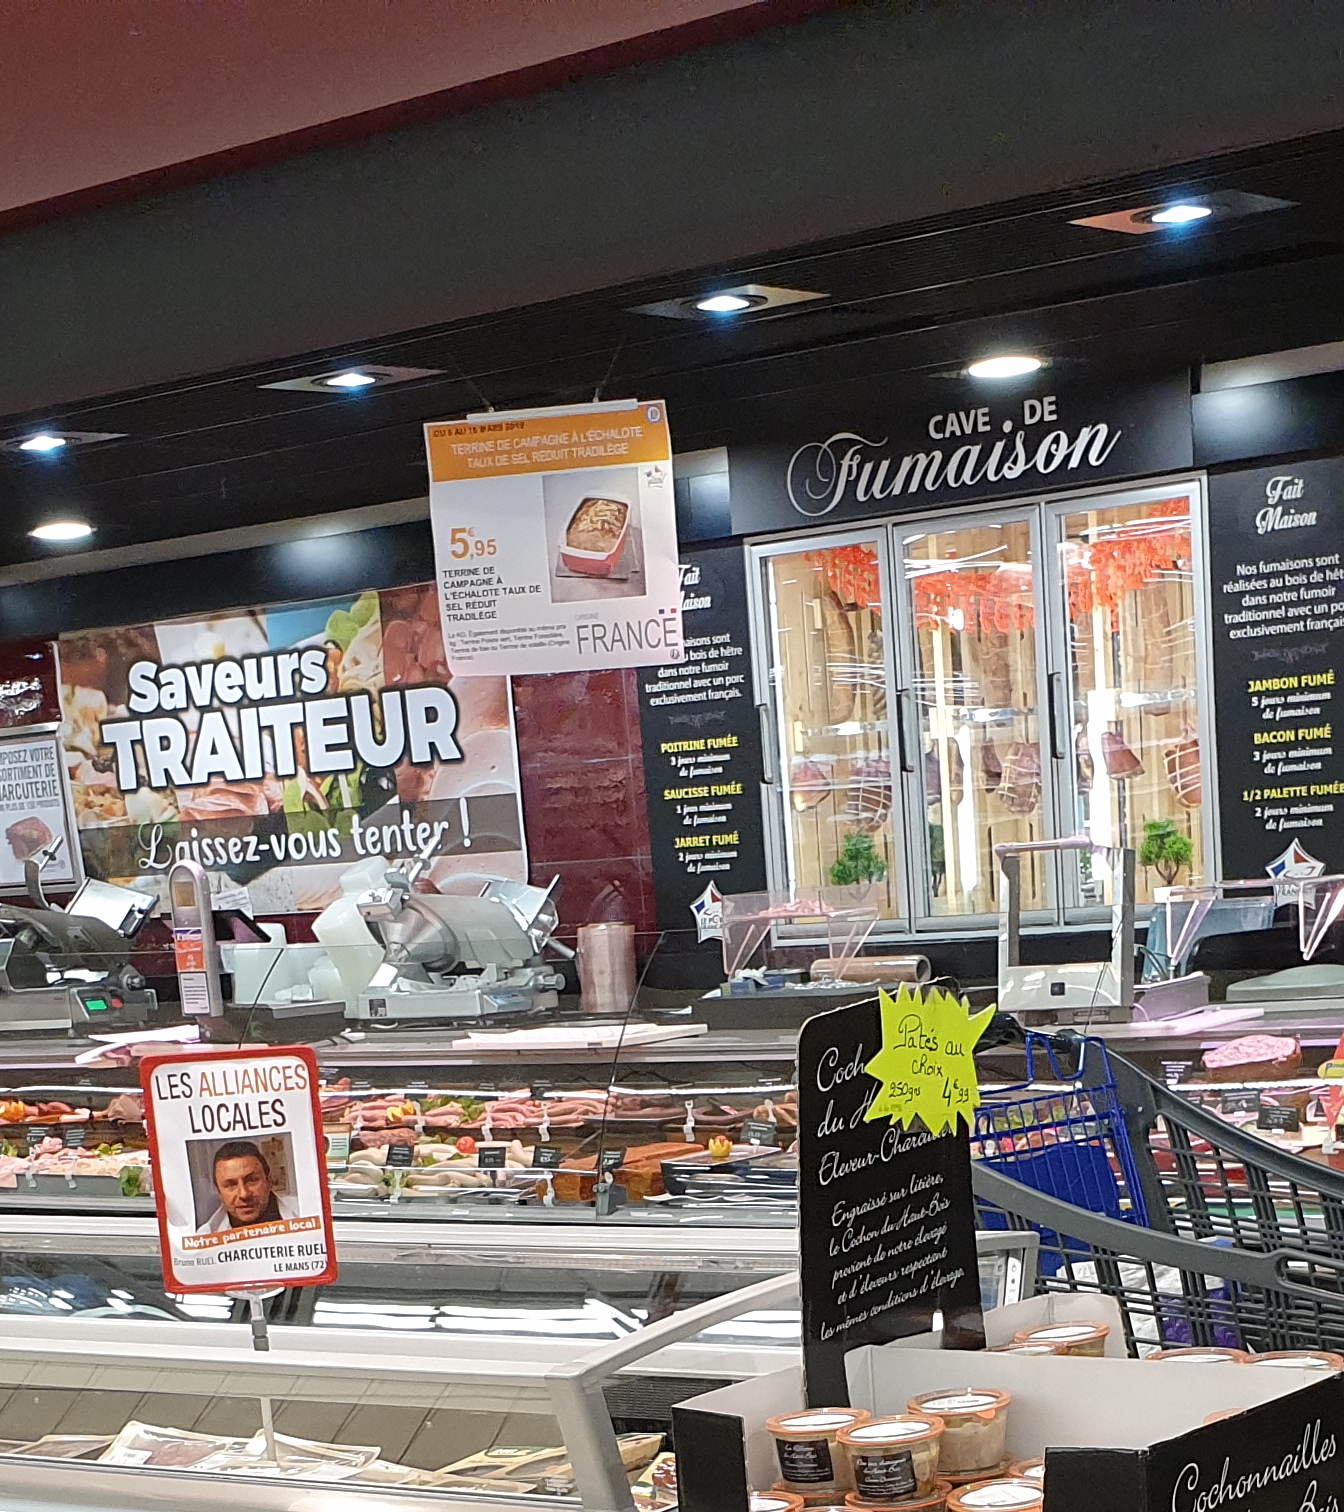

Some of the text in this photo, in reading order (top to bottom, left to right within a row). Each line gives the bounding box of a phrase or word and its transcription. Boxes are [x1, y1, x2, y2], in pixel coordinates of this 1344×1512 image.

[928, 395, 1057, 440] CAVE DE
[787, 422, 1121, 517] Fumaison
[1266, 475, 1304, 505] Fait
[1256, 506, 1317, 535] Maison
[443, 566, 495, 579] TERRINE DE
[1236, 554, 1340, 576] Nos fumaisons sont
[444, 578, 494, 589] CAMPAGNE
[503, 585, 541, 595] TAUX DE
[1223, 571, 1323, 593] réalisées bois de
[446, 603, 463, 611] SEL
[1242, 586, 1336, 607] dans notre fumoir
[1224, 606, 1285, 624] traditionnel
[1287, 606, 1312, 617] avec
[1314, 603, 1328, 614] un
[576, 617, 678, 654] FRANCE
[1229, 621, 1304, 639] exclusivement
[126, 647, 330, 715] Saveurs
[1248, 669, 1336, 693] JAMBON FUMÉ
[101, 686, 466, 793] TRAITEUR
[1253, 723, 1332, 744] BACON FUMÉ
[29, 747, 54, 761] VOTRE
[661, 740, 705, 753] POITRINE
[45, 763, 55, 777] DE
[664, 781, 743, 800] SAUCISSE FUMÉE
[1243, 790, 1262, 802] 1/2
[1264, 786, 1308, 799] PALETTE
[136, 809, 452, 870] Laissez-vous tenter
[675, 831, 740, 848] JARRET FUMÉ
[945, 1041, 965, 1057] au
[155, 1063, 307, 1100] LES ALLIANCES
[188, 1099, 286, 1134] LOCALES
[818, 1100, 845, 1138] du
[831, 1192, 887, 1228] Engraissé
[184, 1218, 317, 1248] Notre partenaire local
[217, 1243, 327, 1263] CHARCUTERIE RUEL
[273, 1262, 310, 1273] LE MANS
